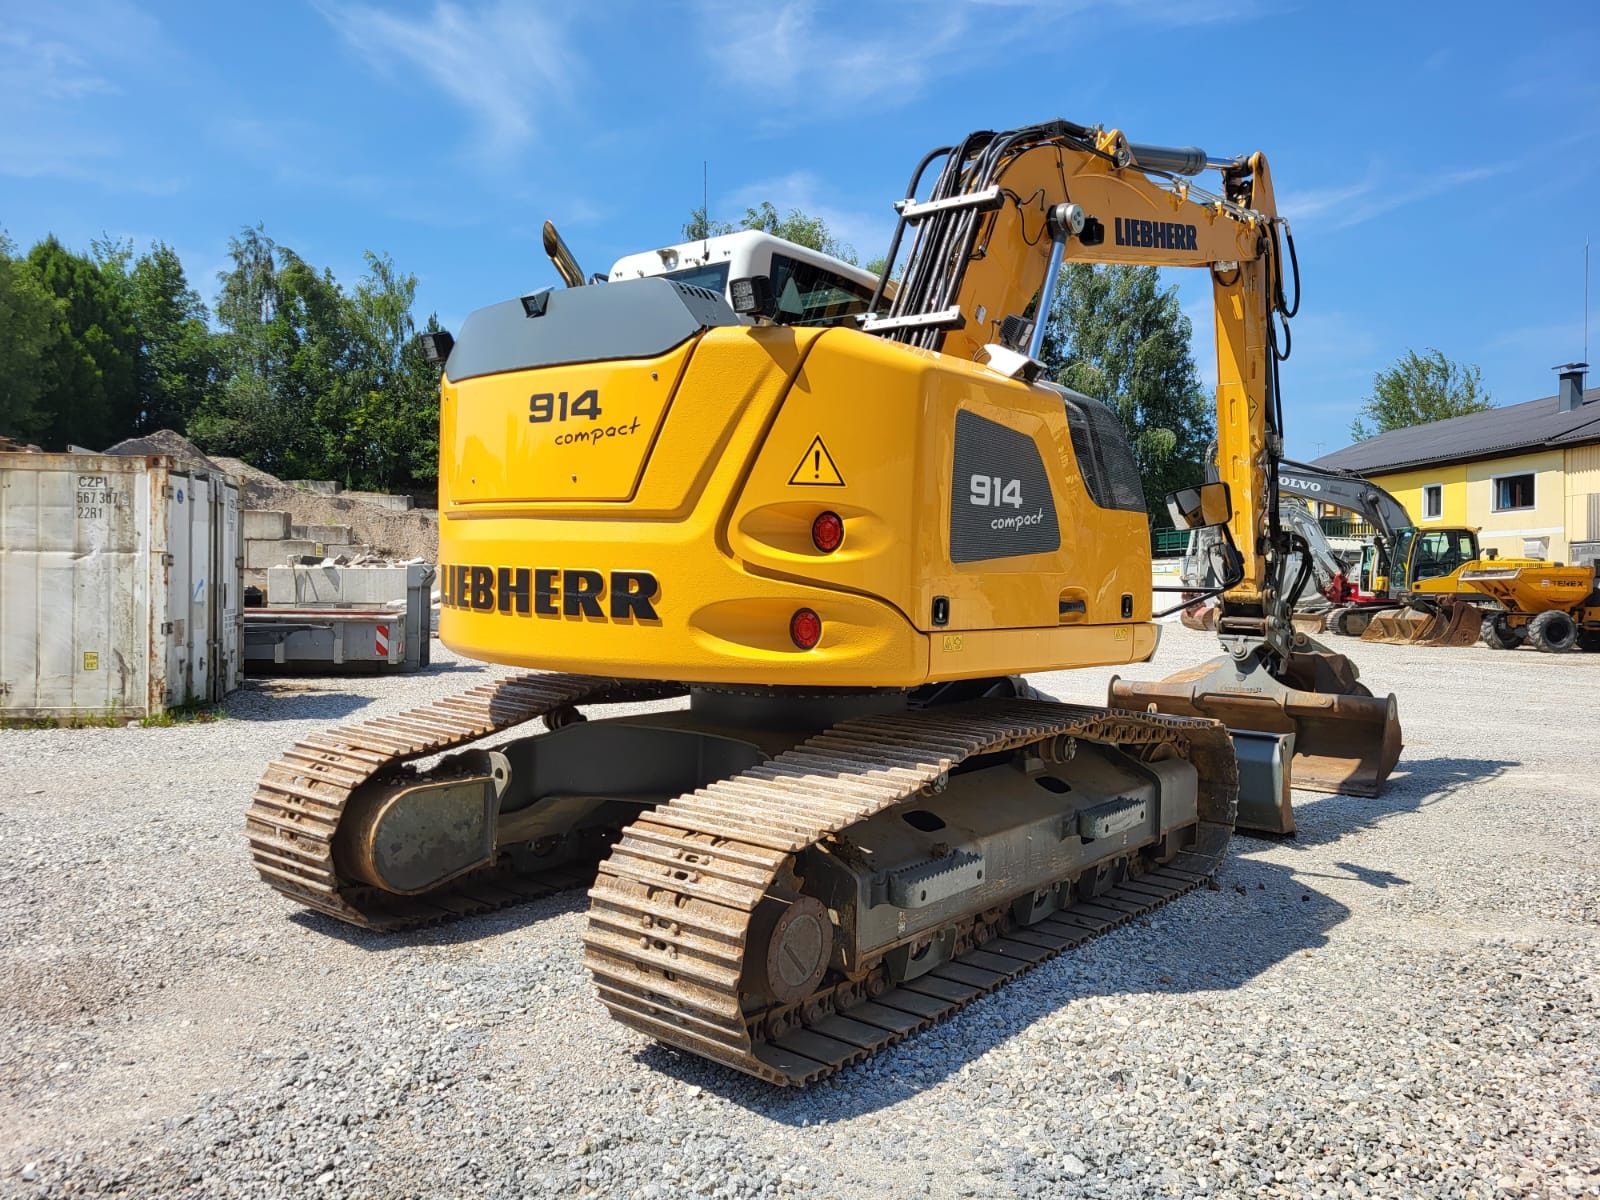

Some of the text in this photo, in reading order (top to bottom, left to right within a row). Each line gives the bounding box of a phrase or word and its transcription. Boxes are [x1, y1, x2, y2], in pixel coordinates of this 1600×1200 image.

[1115, 216, 1199, 251] LIEBHERR
[529, 389, 602, 423] 914
[554, 416, 641, 446] compact
[77, 491, 96, 504] 567
[970, 473, 1023, 509] 914
[1278, 475, 1322, 492] OLVO
[990, 507, 1044, 532] compact
[440, 564, 661, 626] LIEBHERR
[1551, 579, 1585, 588] TEREX
